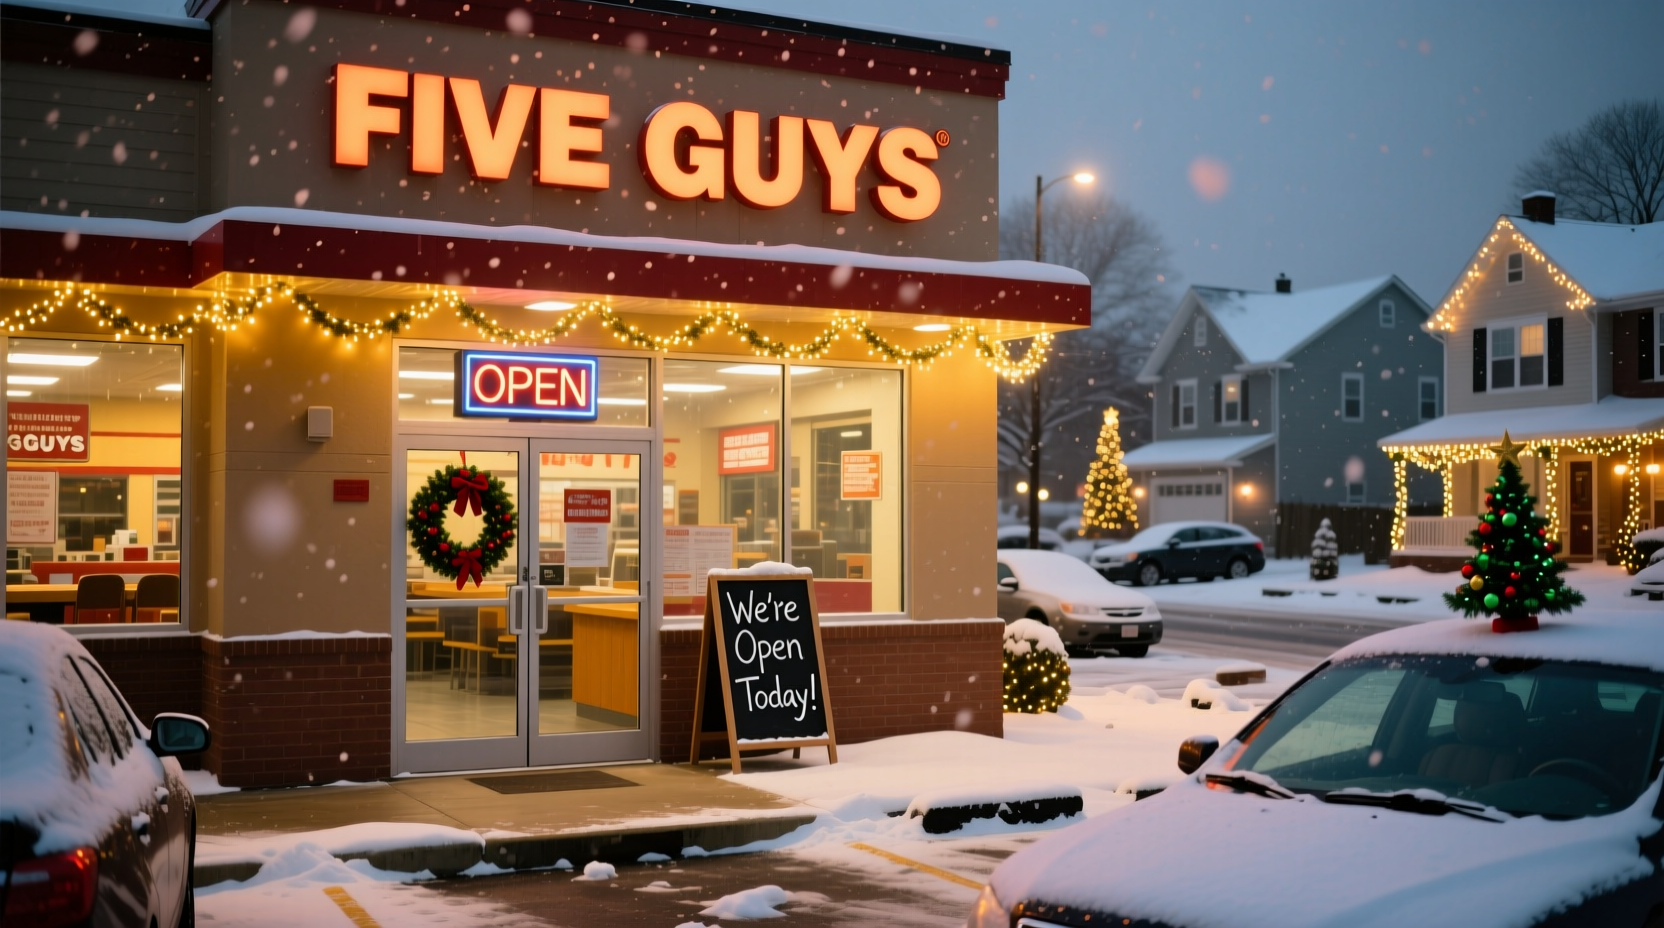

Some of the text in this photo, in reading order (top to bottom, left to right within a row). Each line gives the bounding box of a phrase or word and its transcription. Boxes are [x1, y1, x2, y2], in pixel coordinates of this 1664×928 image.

[332, 62, 611, 191] FIVE
[474, 364, 586, 407] OPEN
[726, 590, 800, 625] We're
[735, 629, 804, 674] Open
[735, 673, 817, 721] Today!
